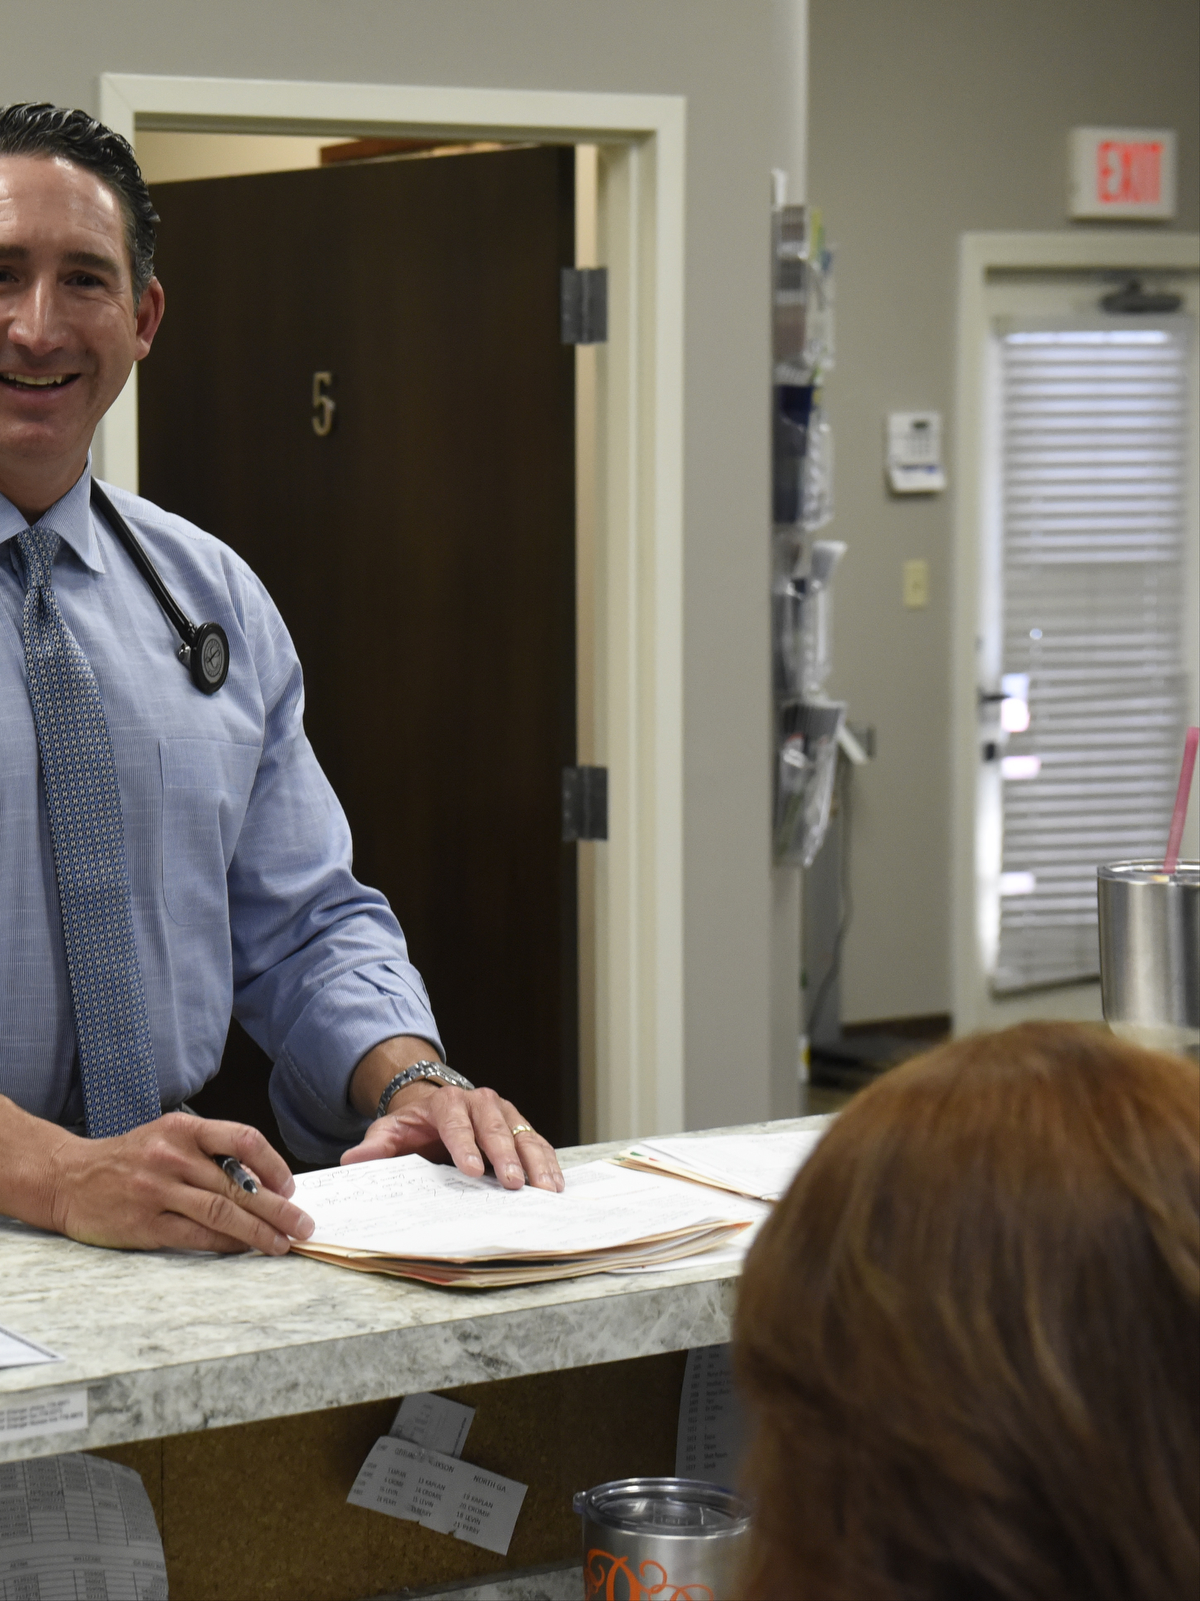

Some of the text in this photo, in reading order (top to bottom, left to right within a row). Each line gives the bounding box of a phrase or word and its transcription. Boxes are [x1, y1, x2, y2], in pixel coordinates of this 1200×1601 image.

[1097, 140, 1162, 204] EXIT
[311, 370, 336, 437] 5
[425, 1479, 446, 1492] KAPLAN
[473, 1474, 506, 1494] NORTH GA
[419, 1497, 434, 1508] LEVIN
[471, 1495, 494, 1509] KAPLAN
[464, 1514, 481, 1526] LEVIN
[461, 1523, 480, 1536] PERRY
